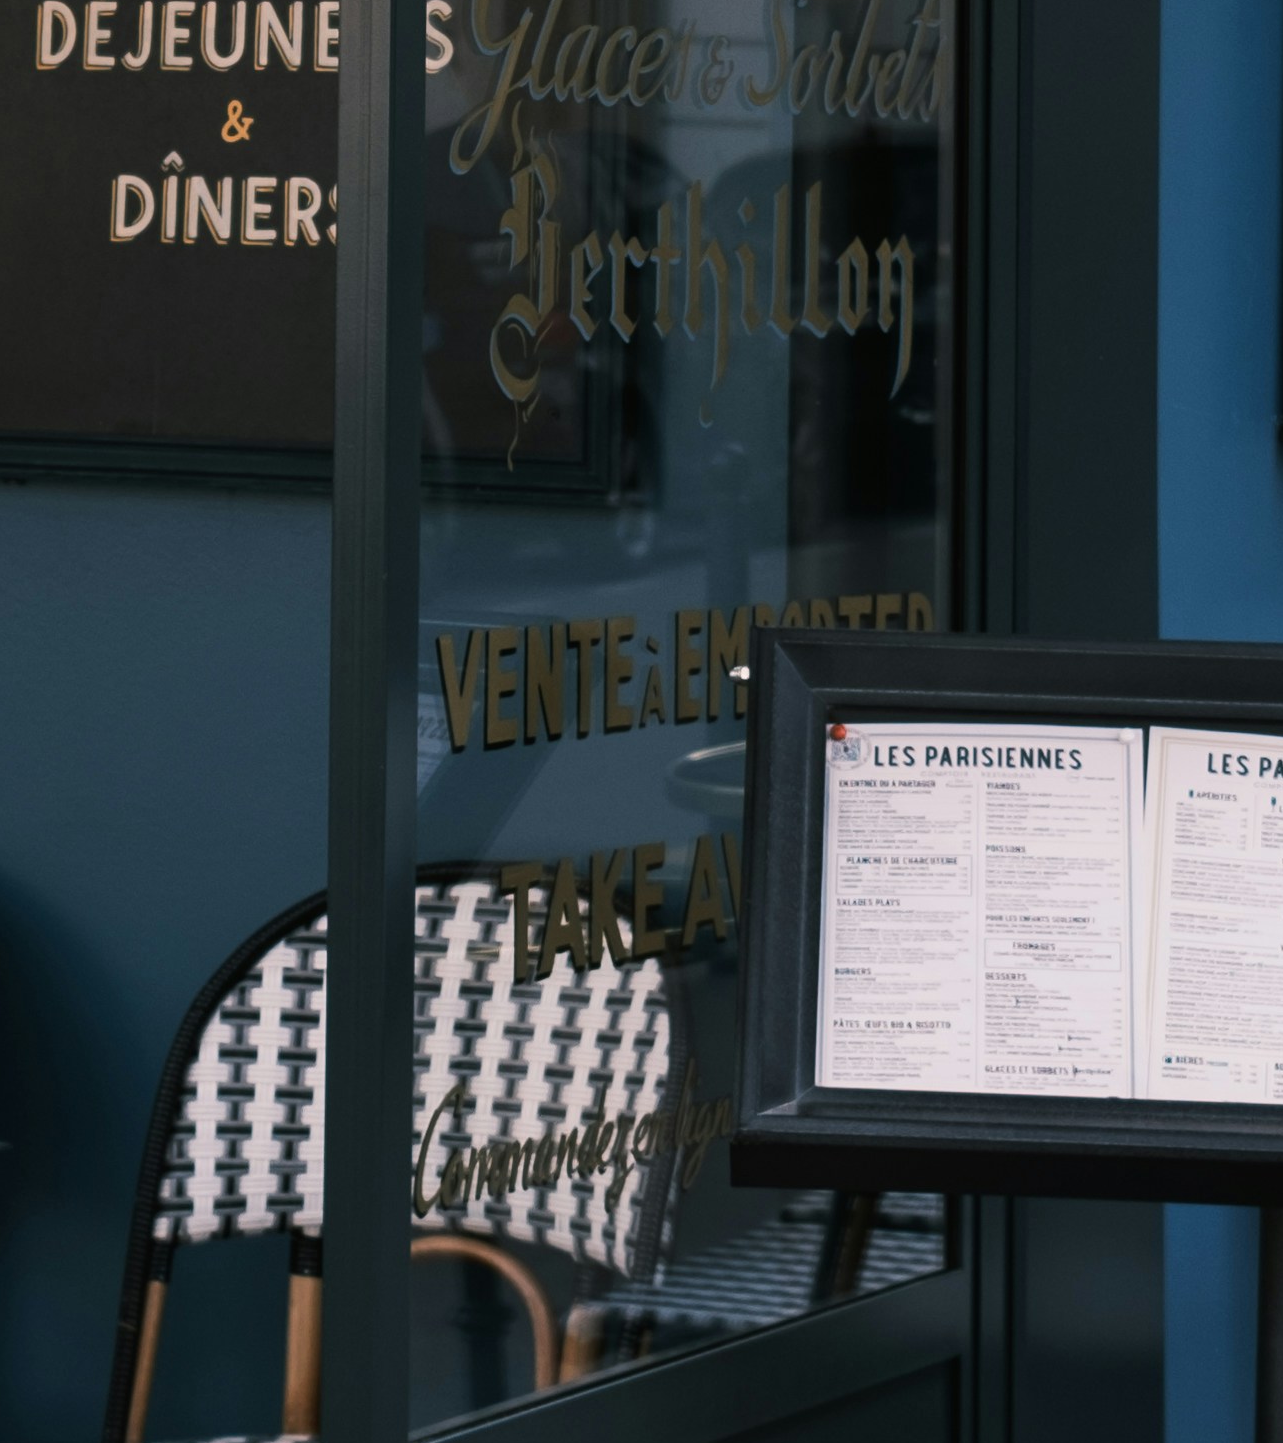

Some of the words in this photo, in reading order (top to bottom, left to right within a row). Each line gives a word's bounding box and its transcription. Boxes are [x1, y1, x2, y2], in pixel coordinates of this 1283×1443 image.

[221, 99, 254, 143] &
[696, 34, 735, 107] &
[490, 135, 915, 427] Berthillon
[435, 616, 636, 754] VENTE
[638, 635, 666, 730] À
[873, 745, 916, 767] LES
[925, 745, 1083, 770] PARISIENNES
[1207, 752, 1250, 776] LES
[500, 840, 667, 984] TAKE
[414, 1080, 634, 1219] Commandez
[674, 1057, 733, 1191] lign
